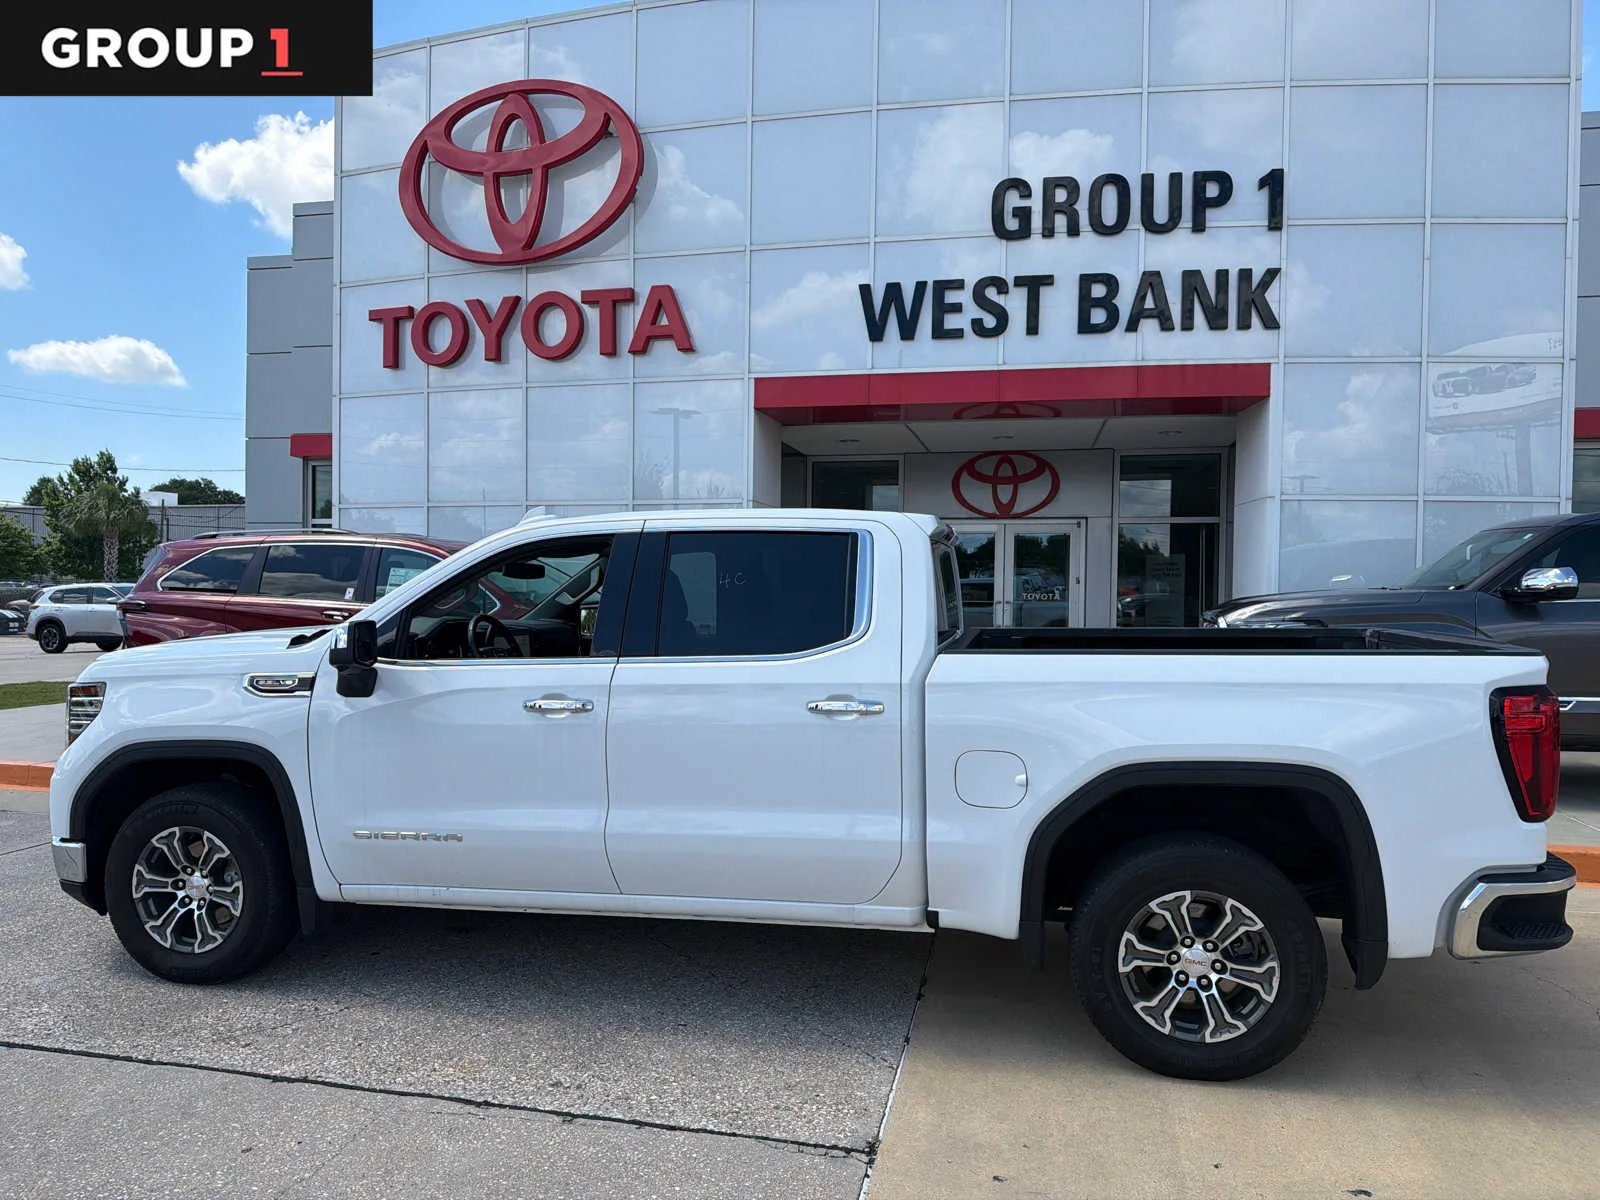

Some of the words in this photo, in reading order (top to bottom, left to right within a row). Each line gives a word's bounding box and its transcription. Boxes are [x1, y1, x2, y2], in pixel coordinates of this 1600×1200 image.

[991, 170, 1234, 241] GROUP
[1257, 168, 1285, 231] 1
[368, 284, 696, 370] TOYOTA
[858, 274, 1054, 342] WEST
[1077, 267, 1282, 335] BANK
[1021, 592, 1060, 601] TOYOTA
[352, 829, 463, 842] SIERRA
